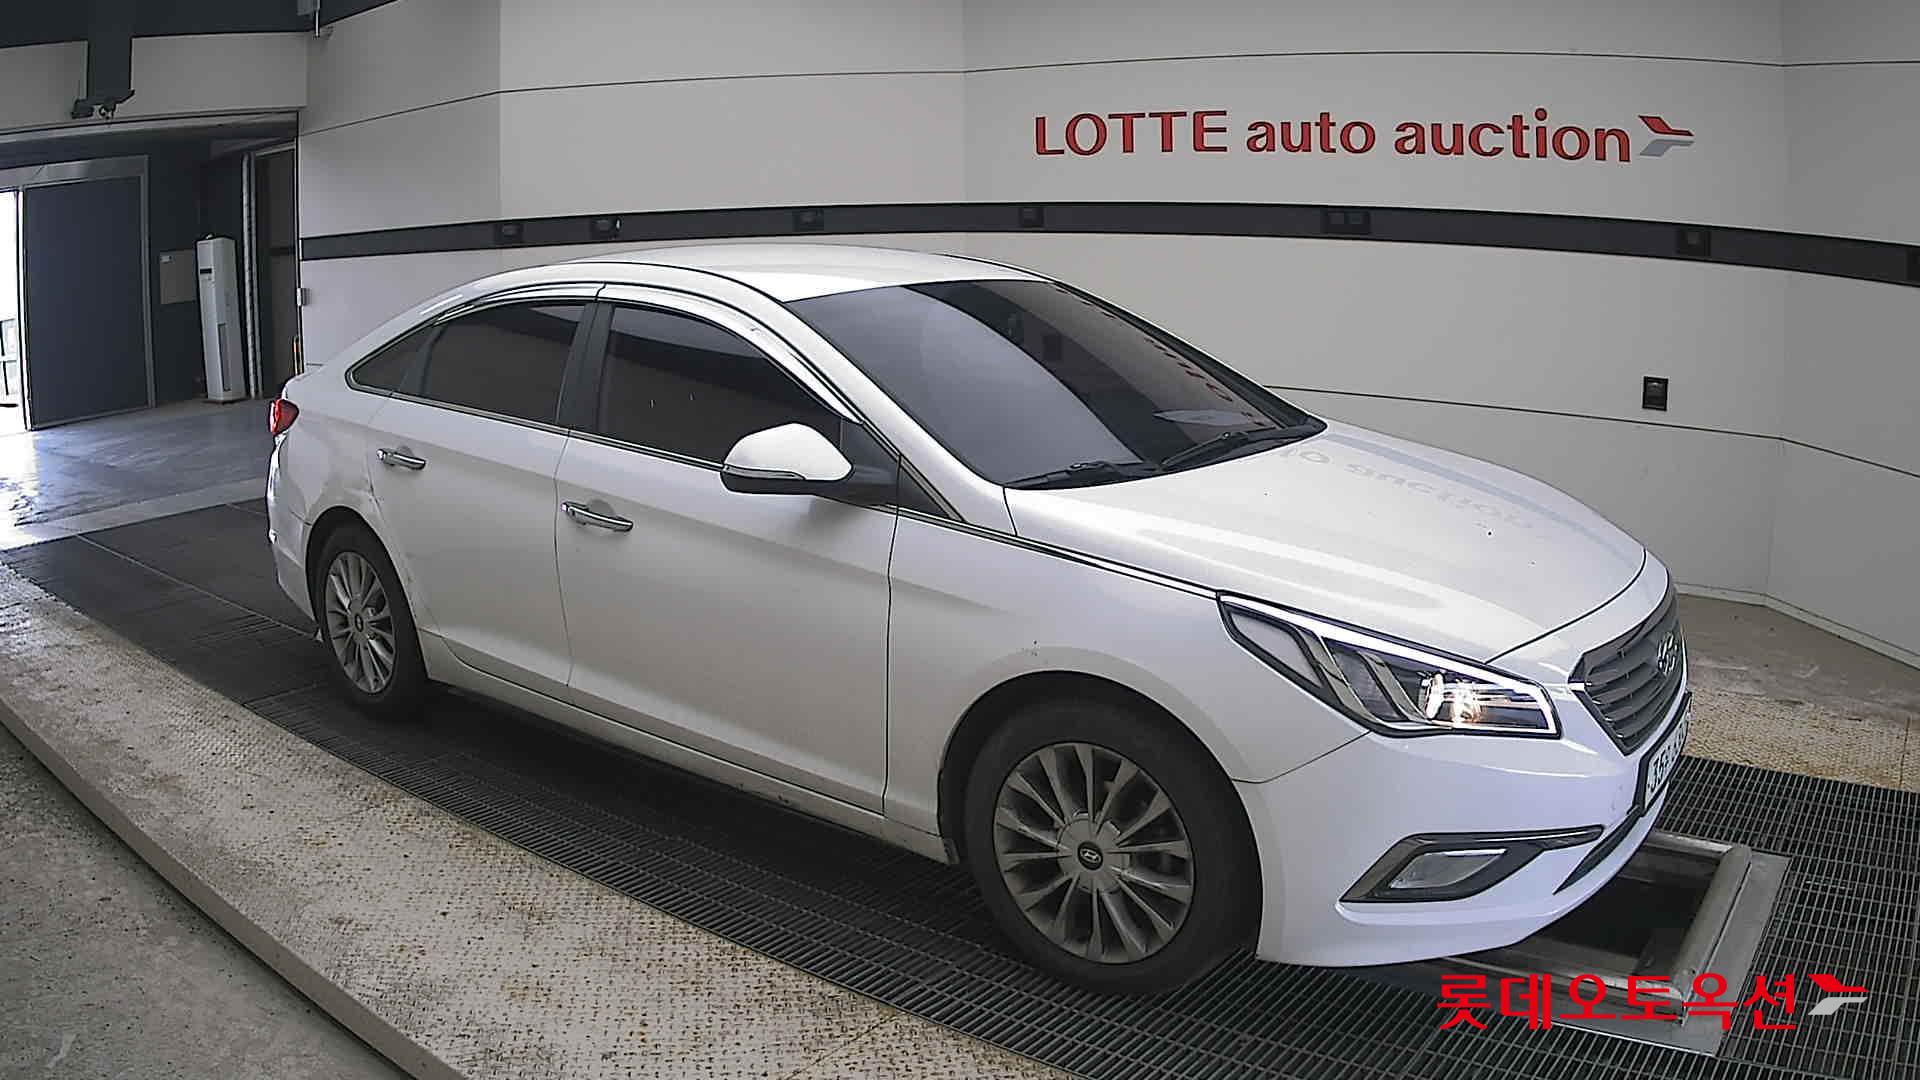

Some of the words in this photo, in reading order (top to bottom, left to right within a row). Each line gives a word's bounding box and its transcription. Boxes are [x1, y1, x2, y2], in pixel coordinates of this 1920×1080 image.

[1034, 109, 1228, 156] LOTTE
[1245, 111, 1377, 155] auto
[1393, 107, 1632, 164] auction
